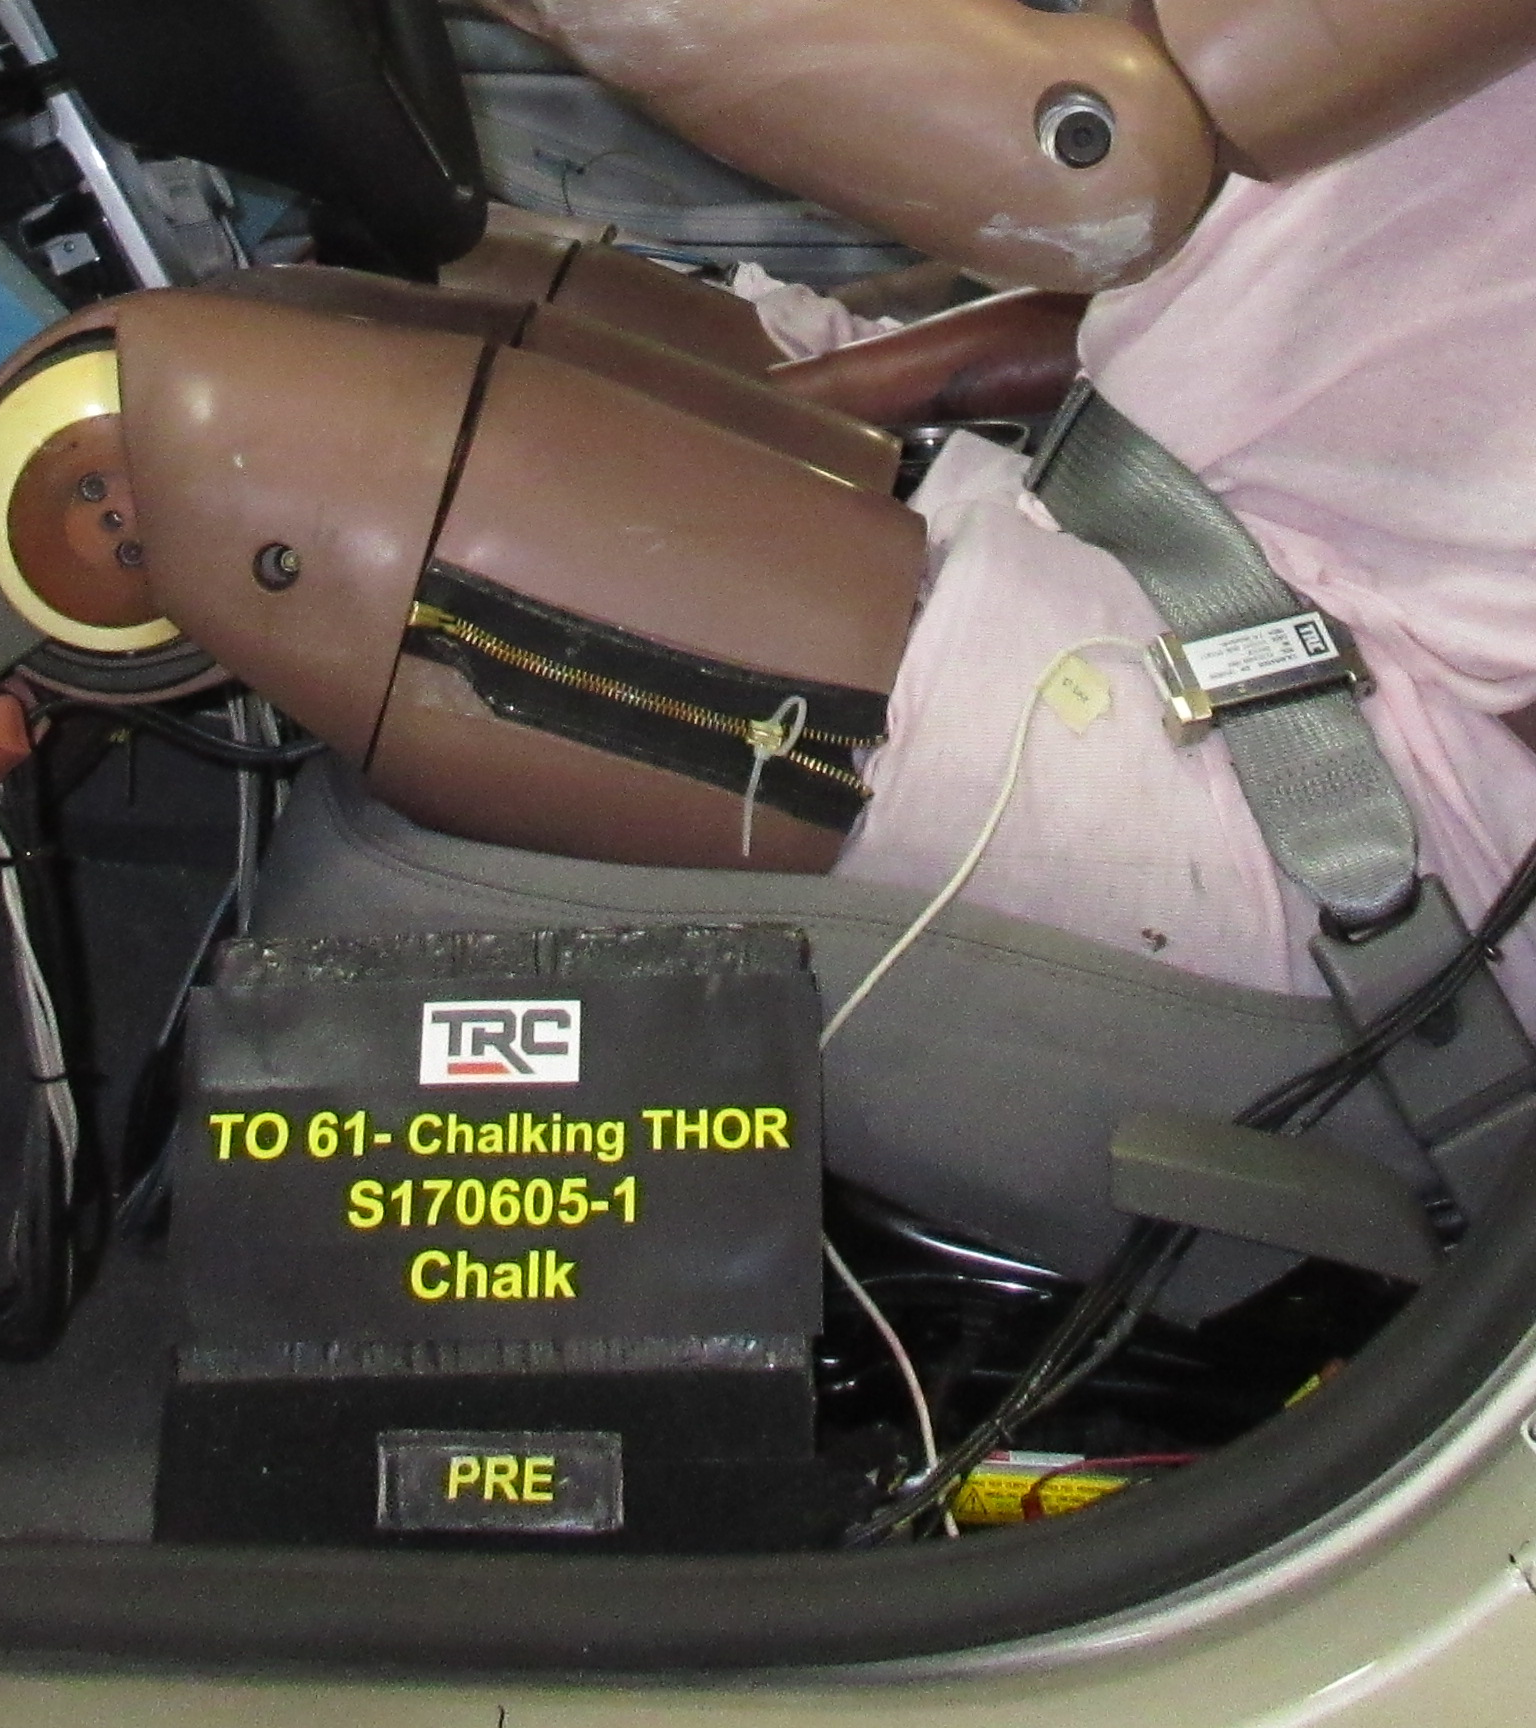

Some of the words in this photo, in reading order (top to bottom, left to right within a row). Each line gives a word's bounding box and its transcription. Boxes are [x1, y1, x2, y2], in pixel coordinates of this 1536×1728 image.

[431, 1008, 572, 1074] TRC
[210, 1113, 290, 1161] TO
[307, 1110, 392, 1159] 61-
[408, 1112, 626, 1165] Chalking
[642, 1108, 790, 1151] THOR
[349, 1178, 638, 1231] S170605-1
[410, 1250, 576, 1302] Chalk
[447, 1458, 555, 1504] PRE
